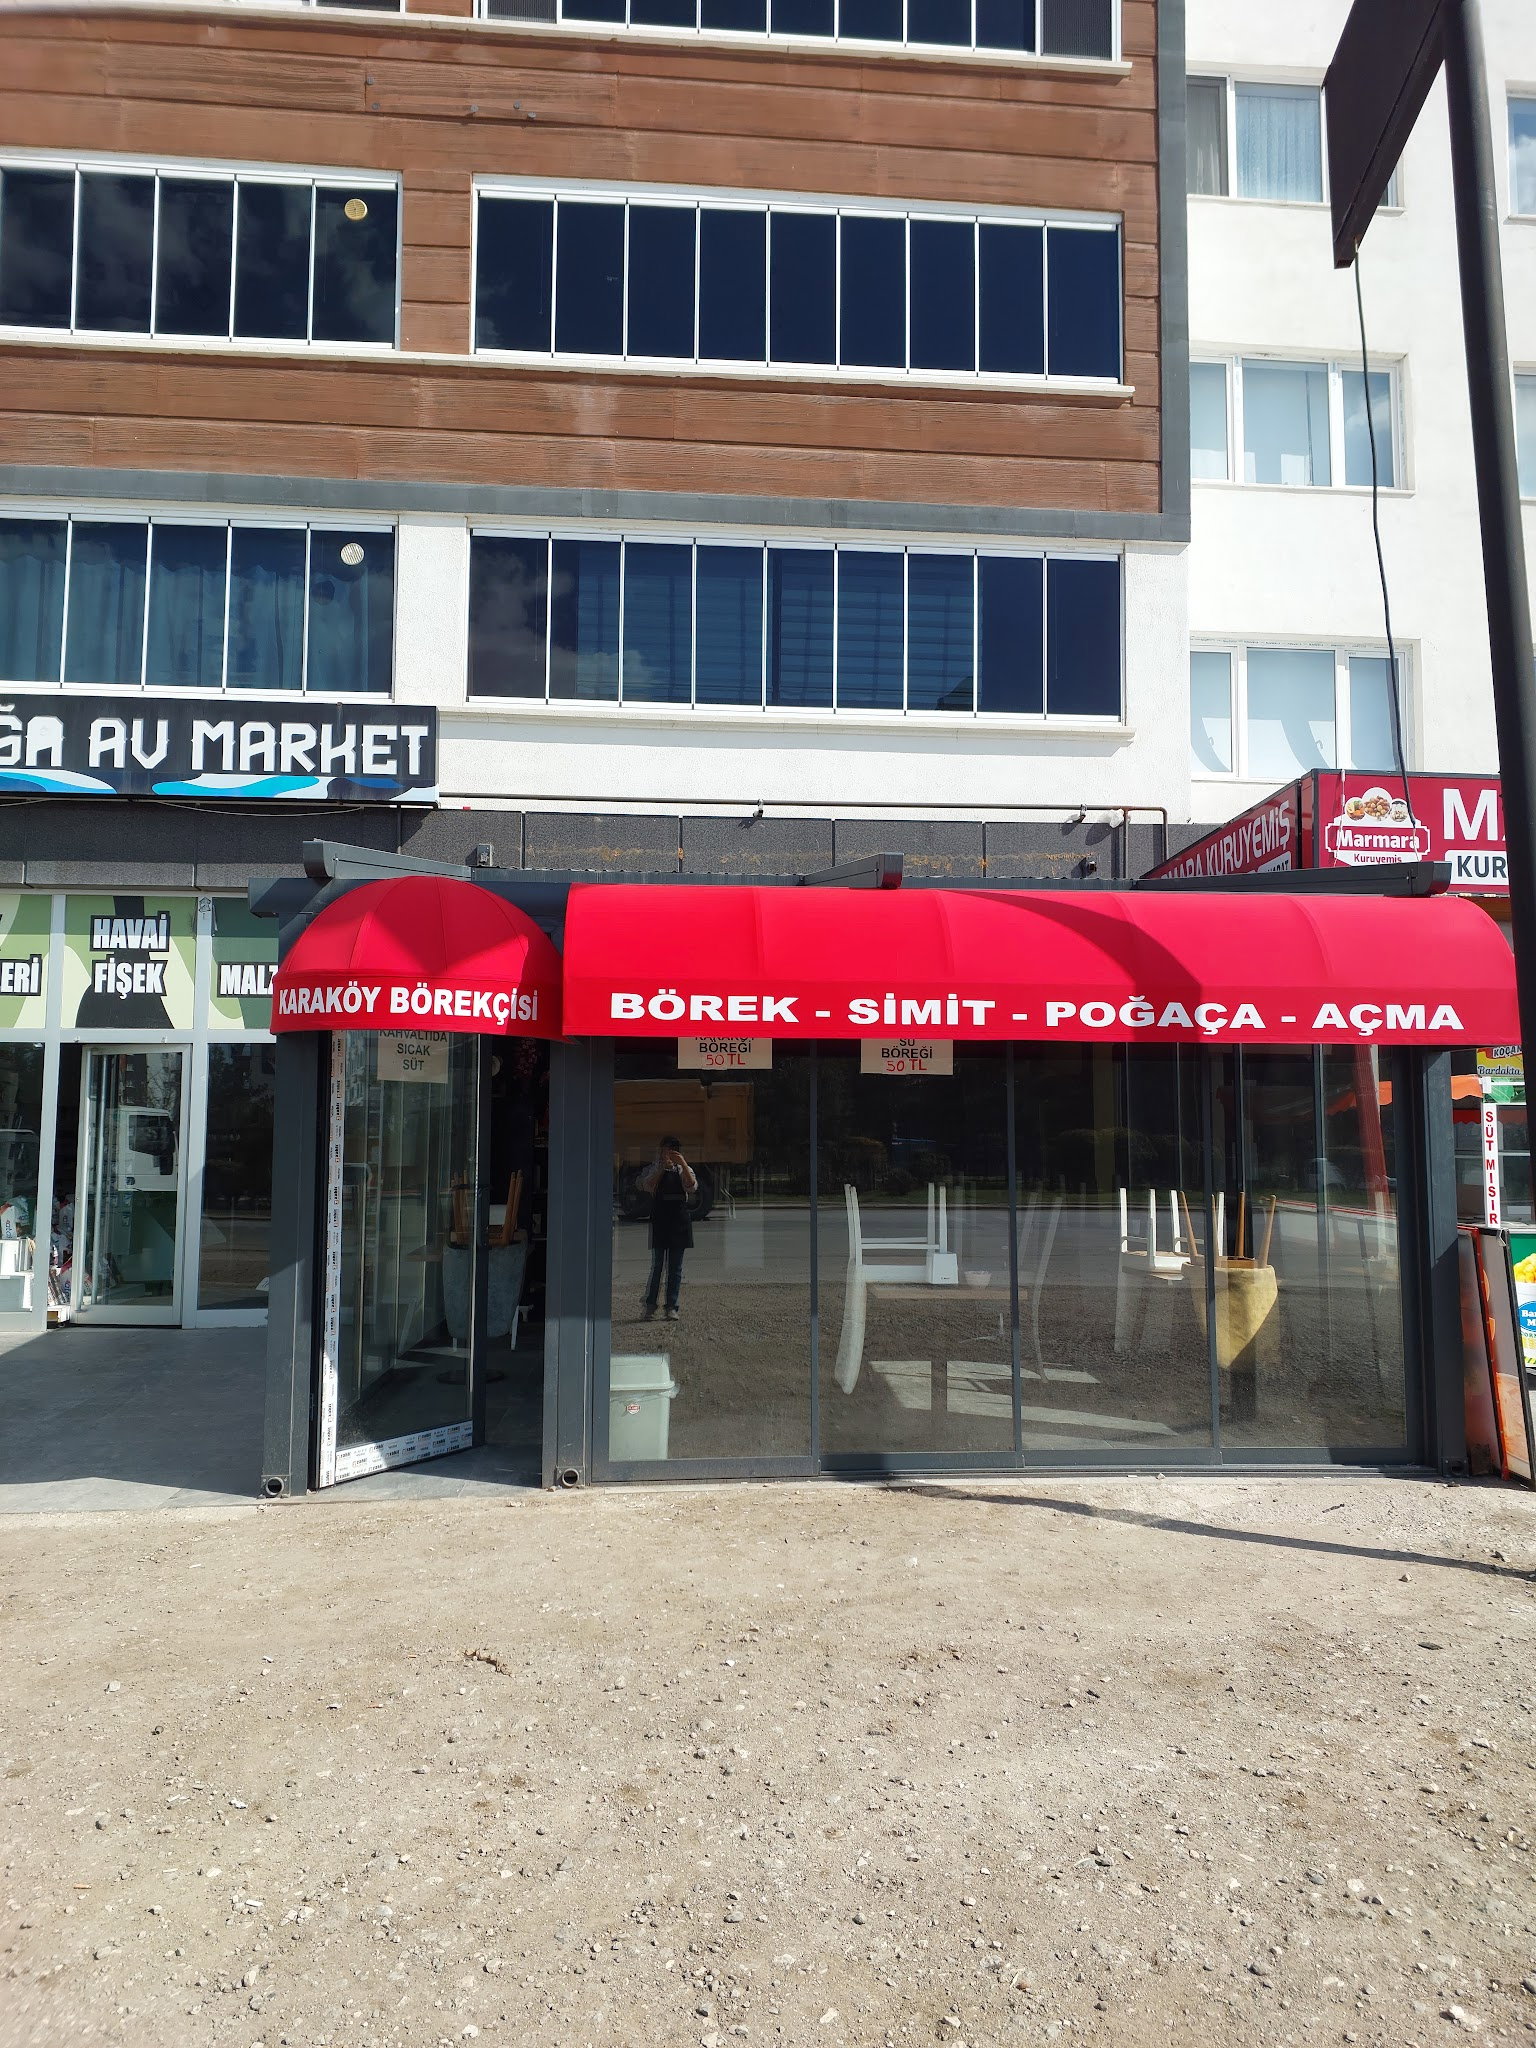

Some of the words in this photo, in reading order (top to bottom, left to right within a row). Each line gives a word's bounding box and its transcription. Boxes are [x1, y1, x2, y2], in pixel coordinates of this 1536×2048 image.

[88, 717, 170, 769] AV
[191, 720, 429, 775] MARKET
[1443, 788, 1507, 841] M
[1335, 829, 1420, 850] Marmara
[1457, 855, 1507, 879] KUR
[93, 914, 168, 949] HAVAİ
[0, 957, 39, 993] ERİ
[94, 957, 164, 999] FİŞEK
[278, 980, 381, 1014] KARAKÖY
[390, 982, 538, 1026] BÖREKÇİSİ
[610, 988, 799, 1023] BÖREK
[847, 993, 996, 1026] SİMİT
[1045, 995, 1267, 1036] POĞAÇA
[1311, 1002, 1465, 1037] AÇMA
[380, 1029, 447, 1042] KAHVALTIDA
[396, 1043, 430, 1056] SICAK
[699, 1040, 751, 1053] BÖREĞİ
[402, 1057, 424, 1070] SÜT
[706, 1054, 725, 1066] 50
[727, 1053, 746, 1065] TL
[881, 1045, 933, 1059] BÖREĞİ
[886, 1060, 905, 1072] 50
[909, 1058, 928, 1071] TL
[1485, 1111, 1495, 1152] SÜT
[1486, 1159, 1499, 1225] MISIR
